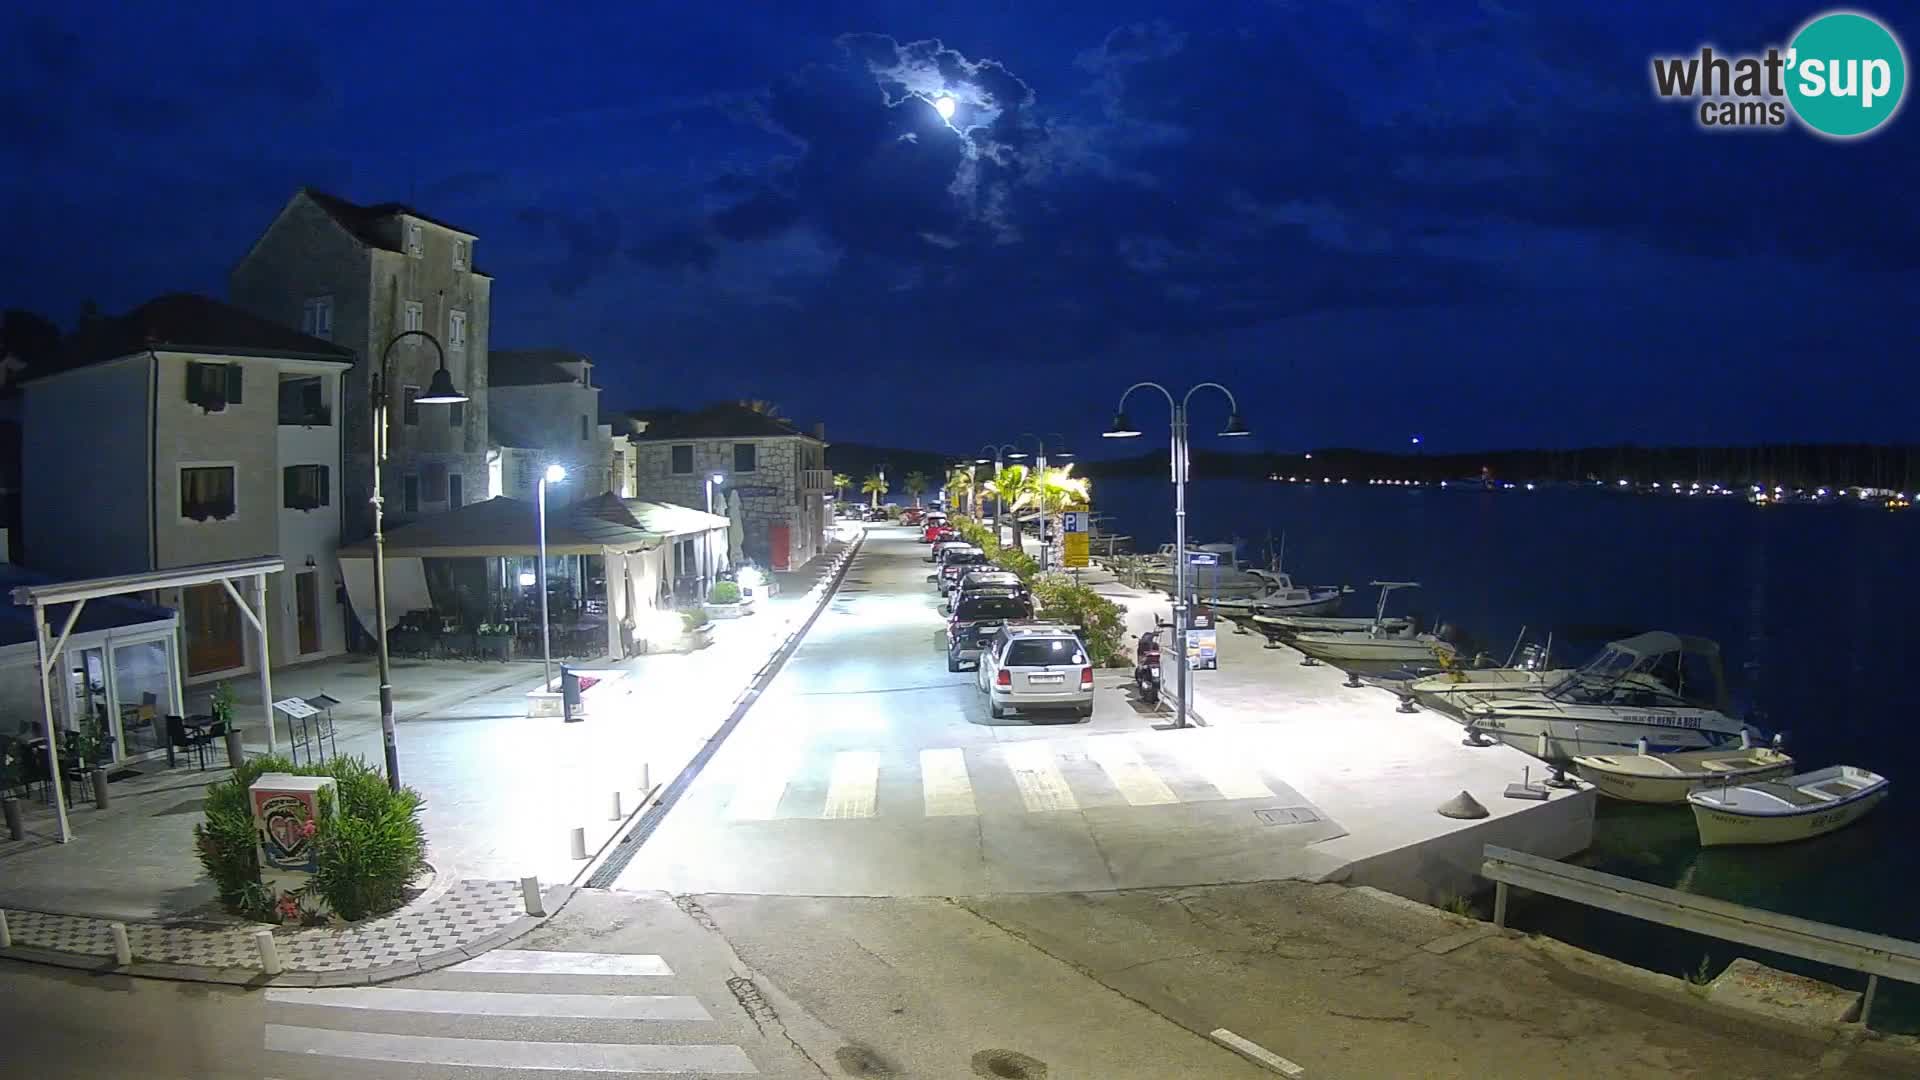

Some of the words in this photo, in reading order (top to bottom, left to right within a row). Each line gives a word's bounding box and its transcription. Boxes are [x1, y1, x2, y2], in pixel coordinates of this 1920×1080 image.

[1065, 514, 1076, 531] P
[1656, 715, 1676, 727] RENT
[1683, 717, 1702, 729] BOAT
